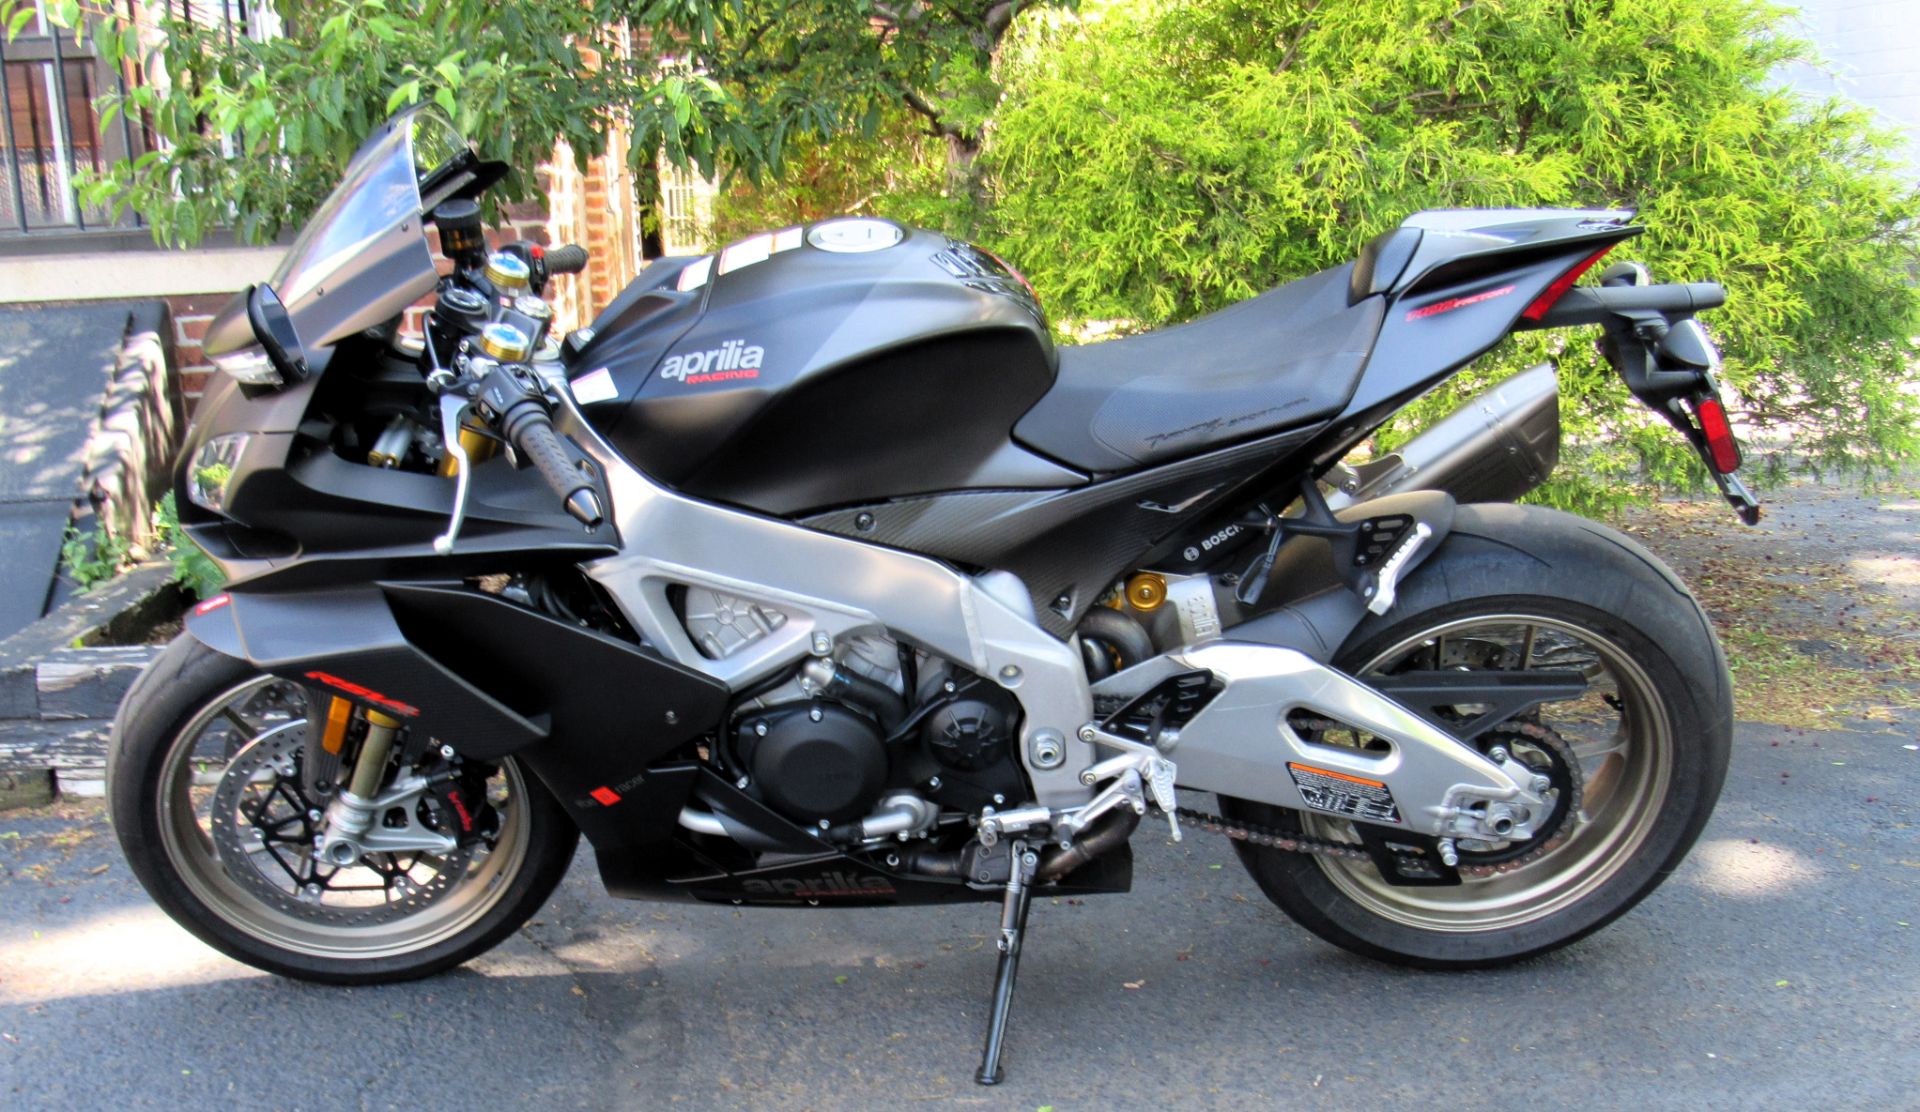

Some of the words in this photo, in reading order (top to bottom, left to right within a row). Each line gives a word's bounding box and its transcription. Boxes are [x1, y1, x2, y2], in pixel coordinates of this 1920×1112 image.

[661, 339, 765, 382] aprilia
[686, 369, 759, 385] RACING
[741, 871, 891, 896] aprilia
